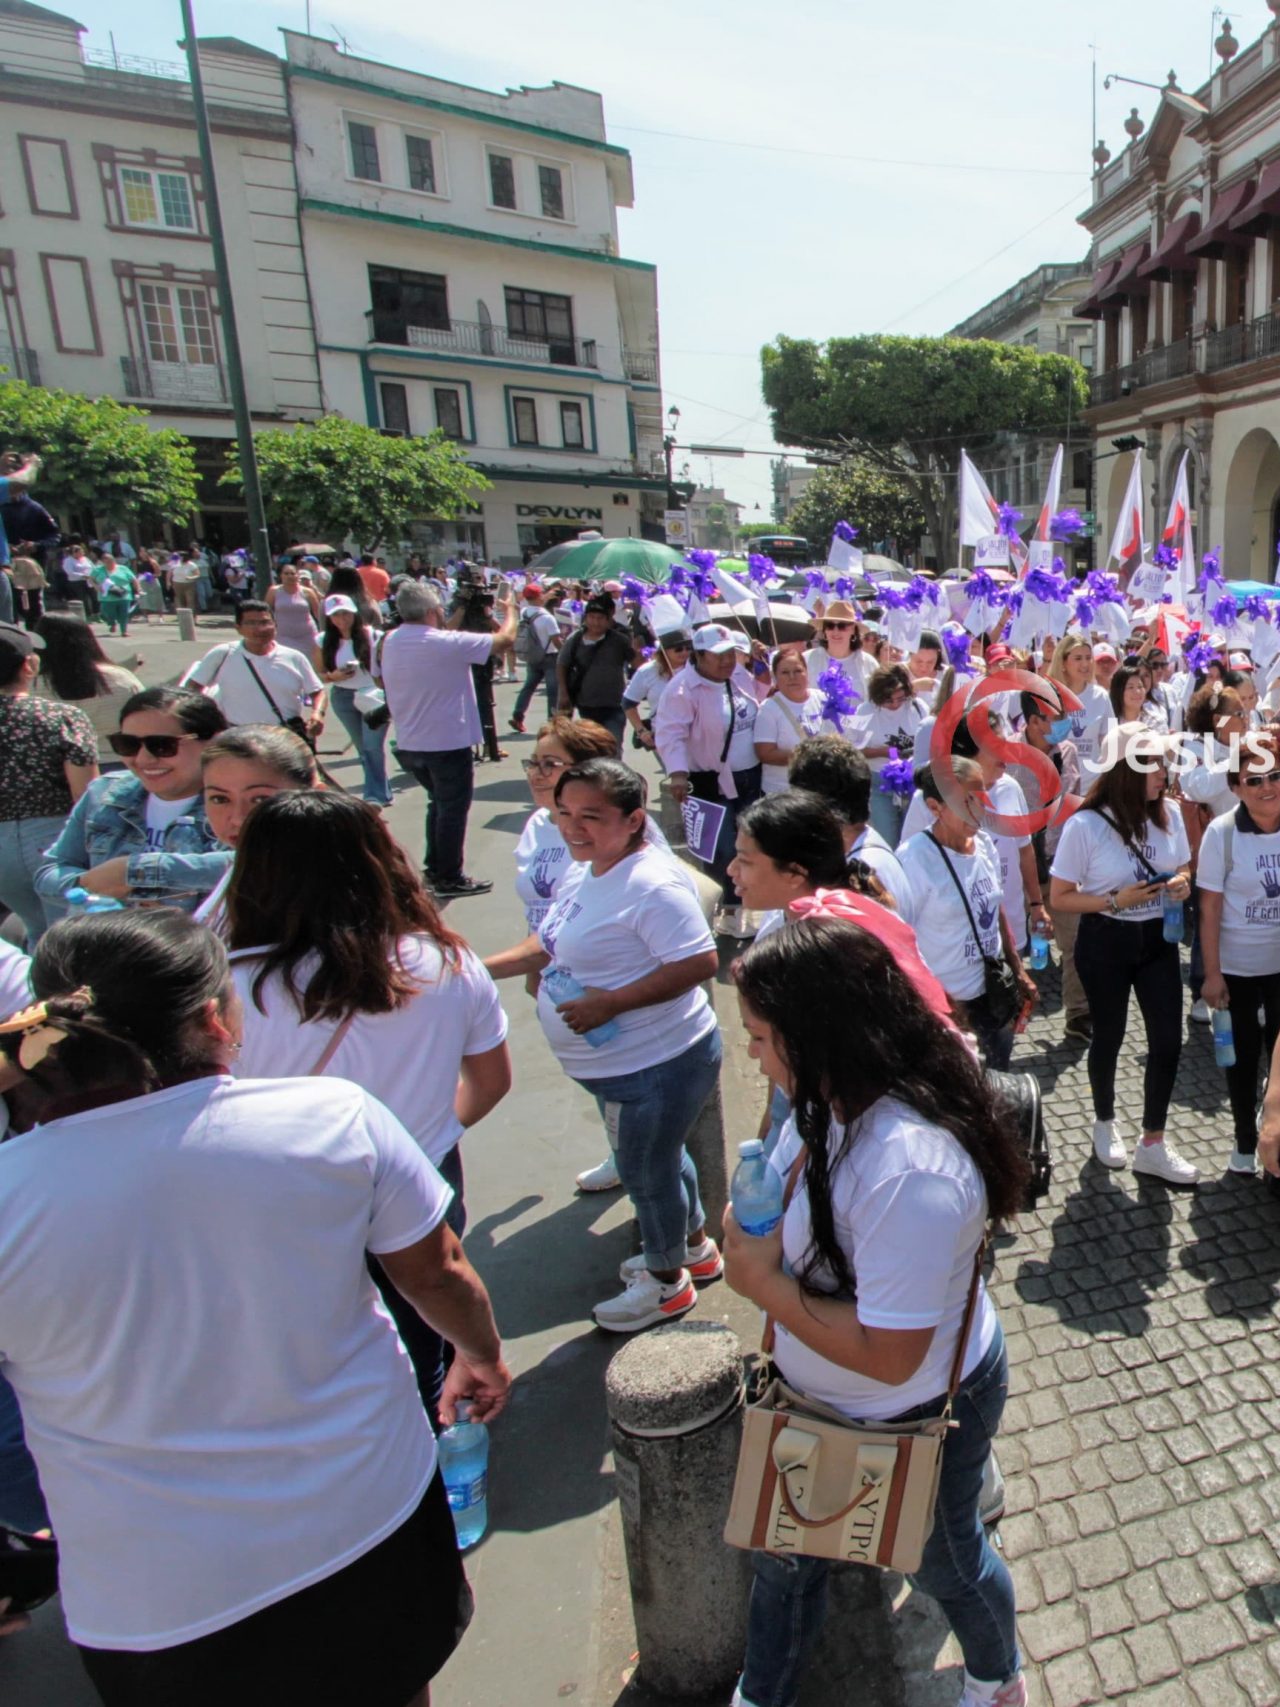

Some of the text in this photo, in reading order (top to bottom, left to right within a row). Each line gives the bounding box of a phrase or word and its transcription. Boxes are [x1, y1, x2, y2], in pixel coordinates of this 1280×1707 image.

[516, 503, 602, 520] DEVLYN
[533, 847, 566, 867] ¡ALTO!
[1245, 906, 1257, 918] DE
